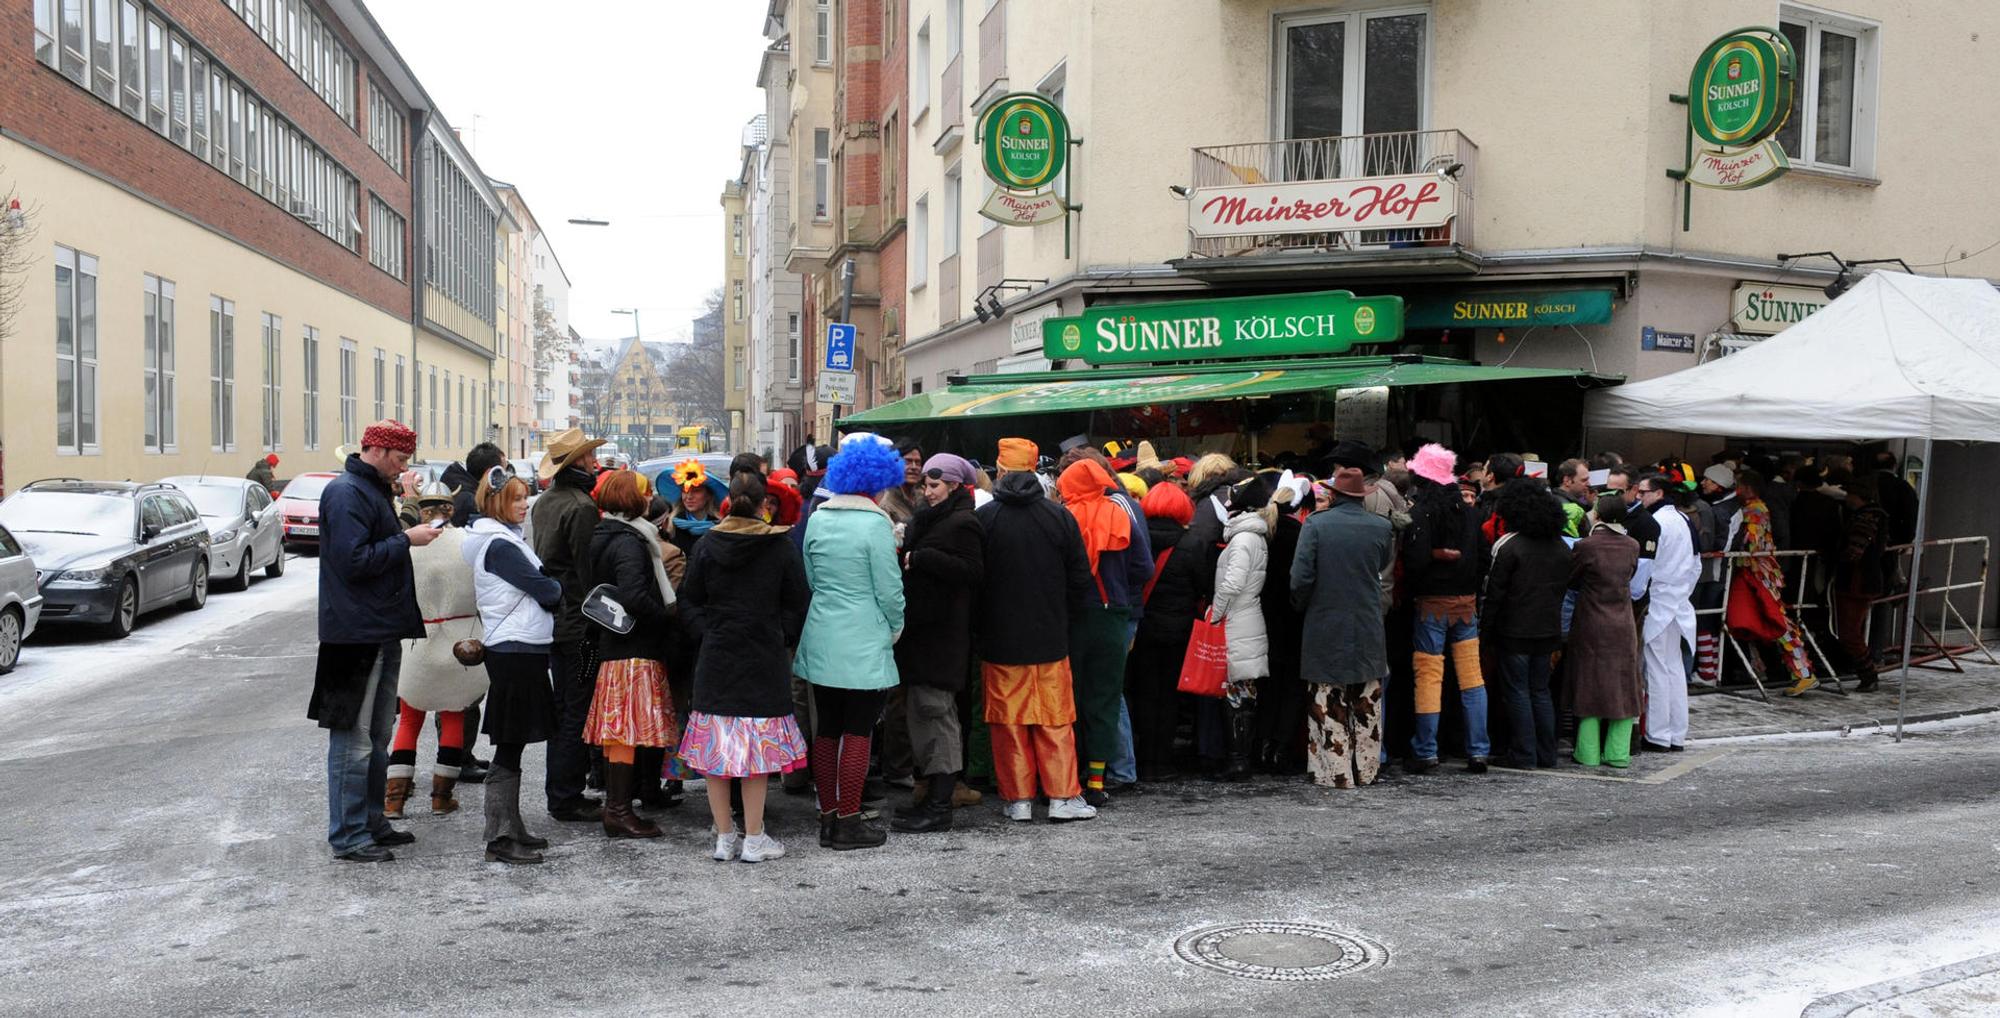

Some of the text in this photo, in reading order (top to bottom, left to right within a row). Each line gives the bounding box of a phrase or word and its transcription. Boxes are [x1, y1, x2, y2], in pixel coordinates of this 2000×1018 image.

[1703, 153, 1762, 173] Mainzer
[1717, 170, 1744, 185] Hof
[999, 195, 1053, 210] Mainzer
[1201, 182, 1441, 226] Mainzer Hof
[1013, 208, 1038, 223] Hof
[1745, 292, 1828, 324] SÜNNE
[831, 328, 845, 348] P
[1096, 315, 1223, 354] SÜNNER
[1234, 313, 1336, 341] KÖLSCH
[1657, 333, 1682, 346] Mainzer
